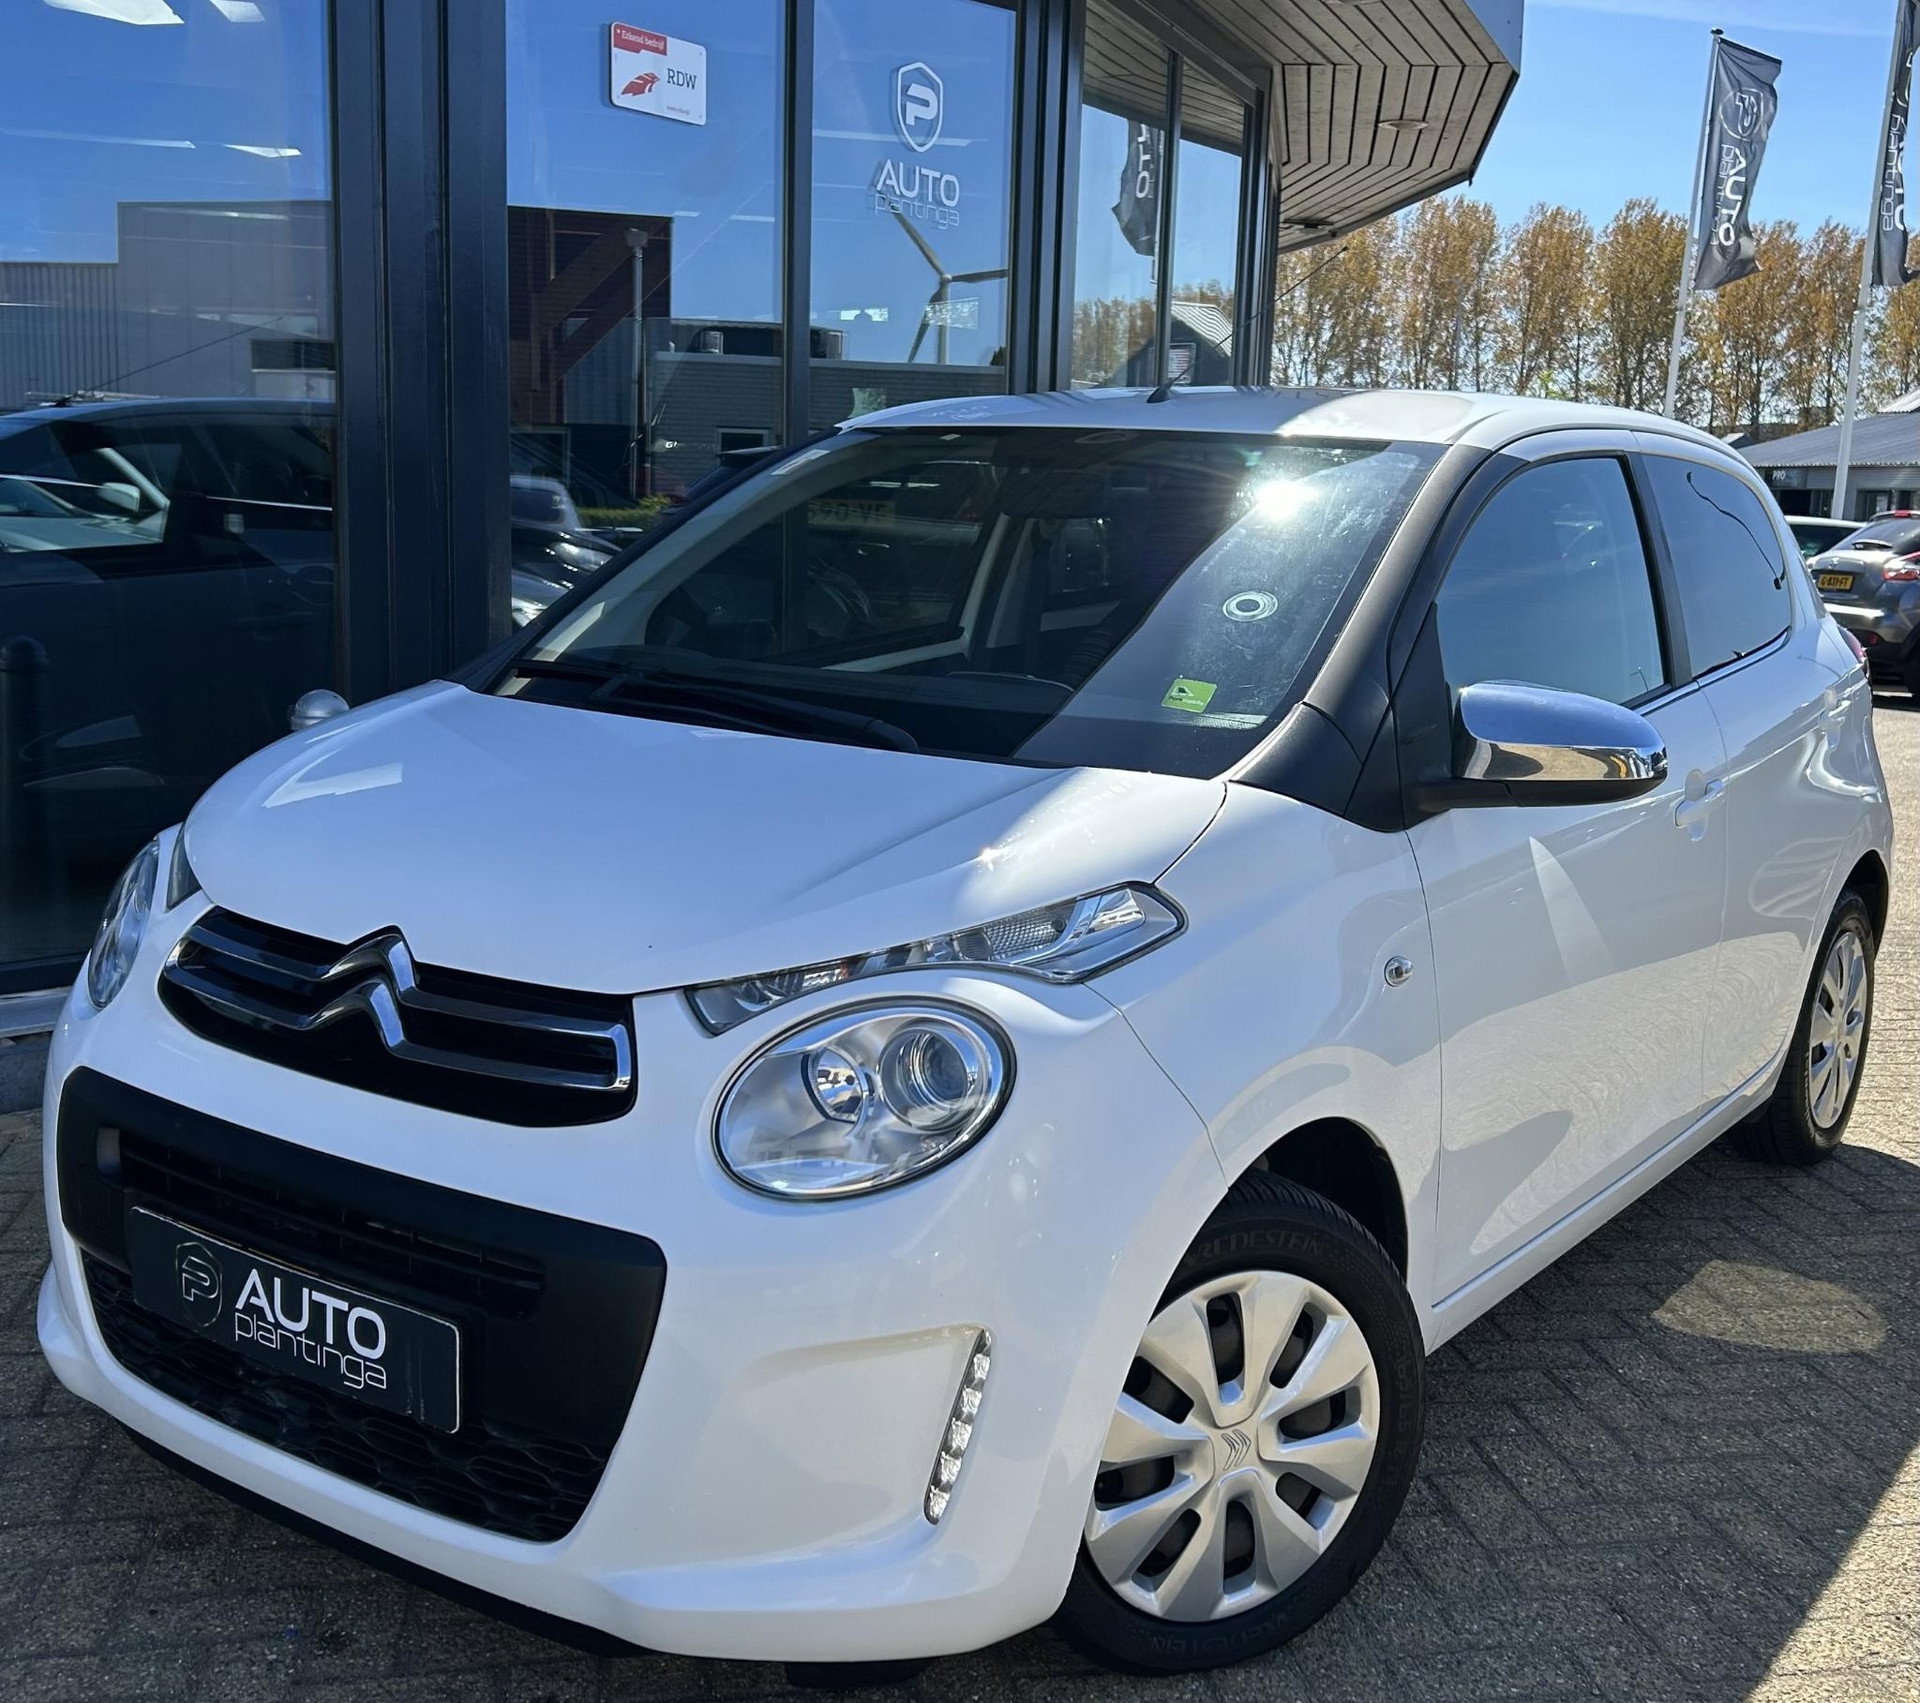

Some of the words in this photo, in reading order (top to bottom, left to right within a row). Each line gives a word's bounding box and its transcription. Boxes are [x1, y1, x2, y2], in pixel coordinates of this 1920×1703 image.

[667, 67, 697, 90] RDW
[874, 192, 960, 230] plantinga
[876, 158, 960, 207] AUTO
[1718, 147, 1746, 247] AUTO
[235, 1268, 387, 1360] AUTO
[235, 1312, 387, 1389] plantinga
